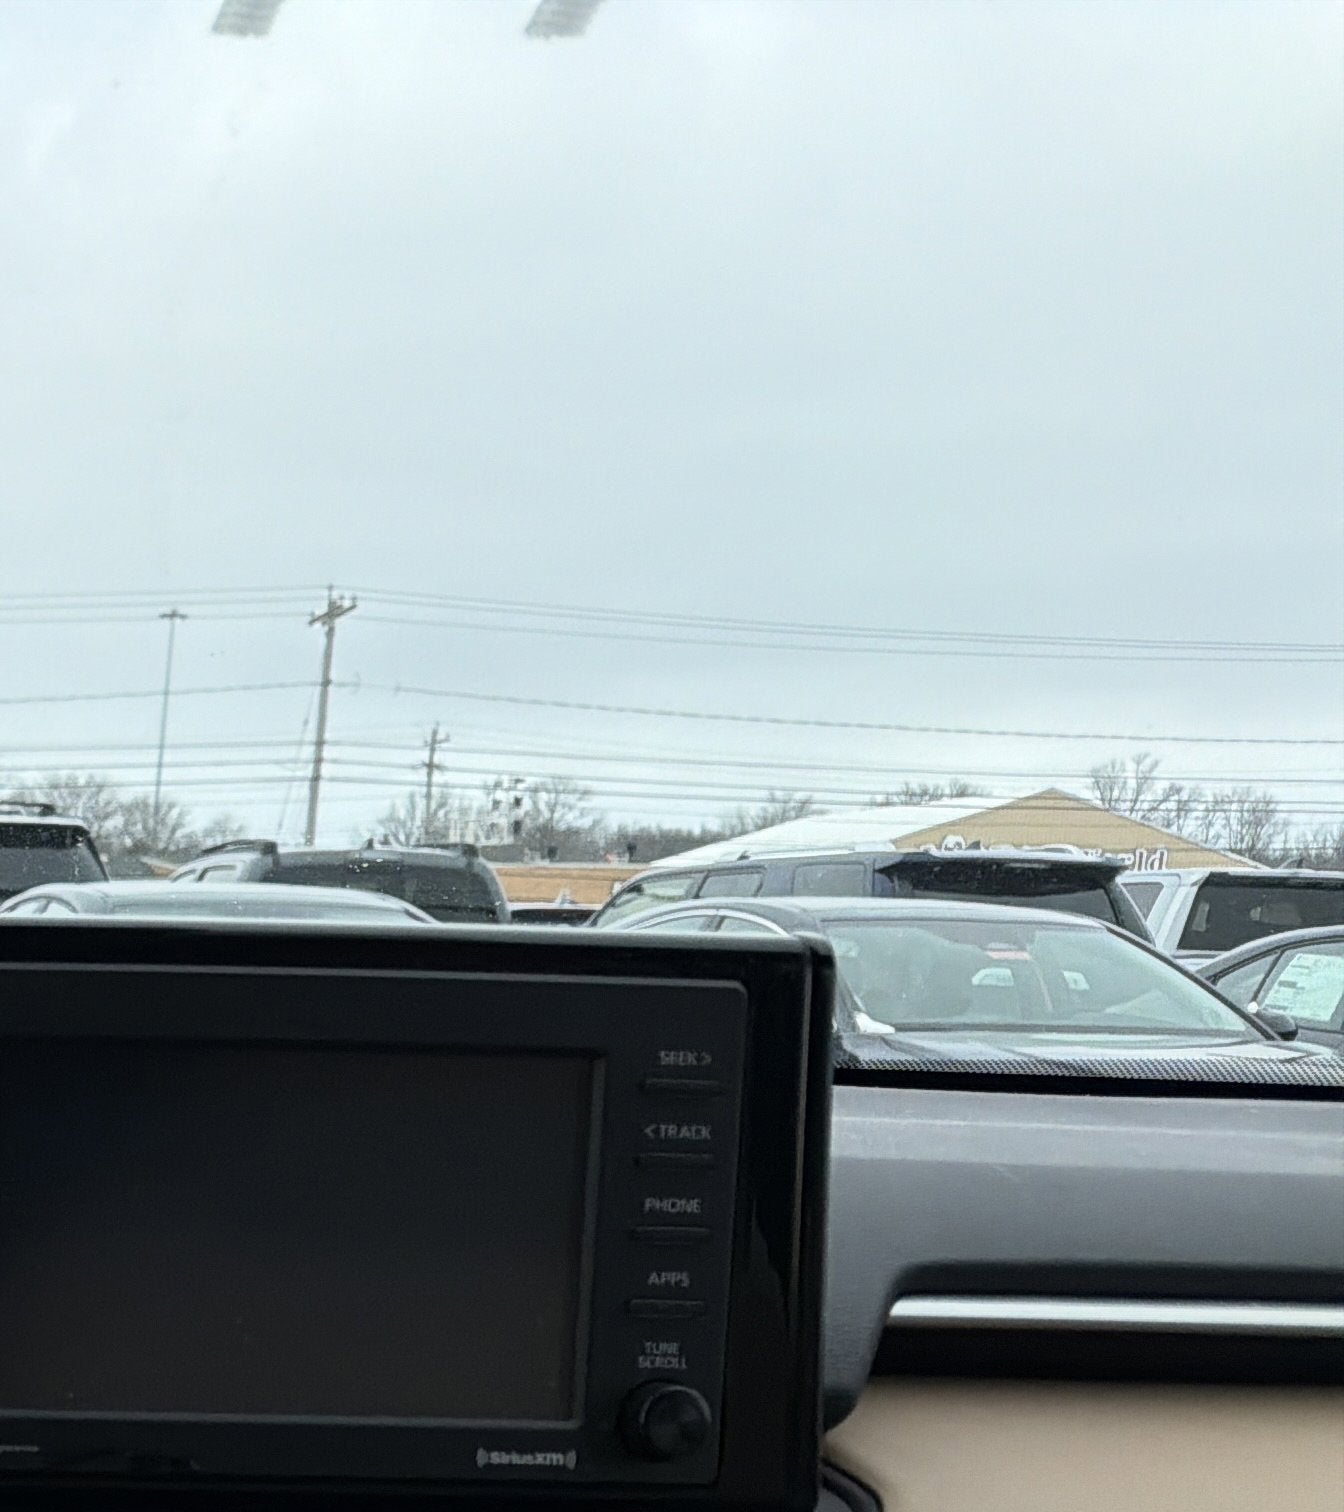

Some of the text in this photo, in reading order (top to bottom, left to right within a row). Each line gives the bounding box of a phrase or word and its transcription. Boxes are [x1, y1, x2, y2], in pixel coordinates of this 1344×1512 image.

[658, 1050, 698, 1066] SEEK
[659, 1123, 712, 1140] TRACK
[644, 1197, 702, 1214] PHONE
[647, 1271, 691, 1288] APPS
[644, 1341, 681, 1354] TUNE
[638, 1355, 688, 1370] SCROLL
